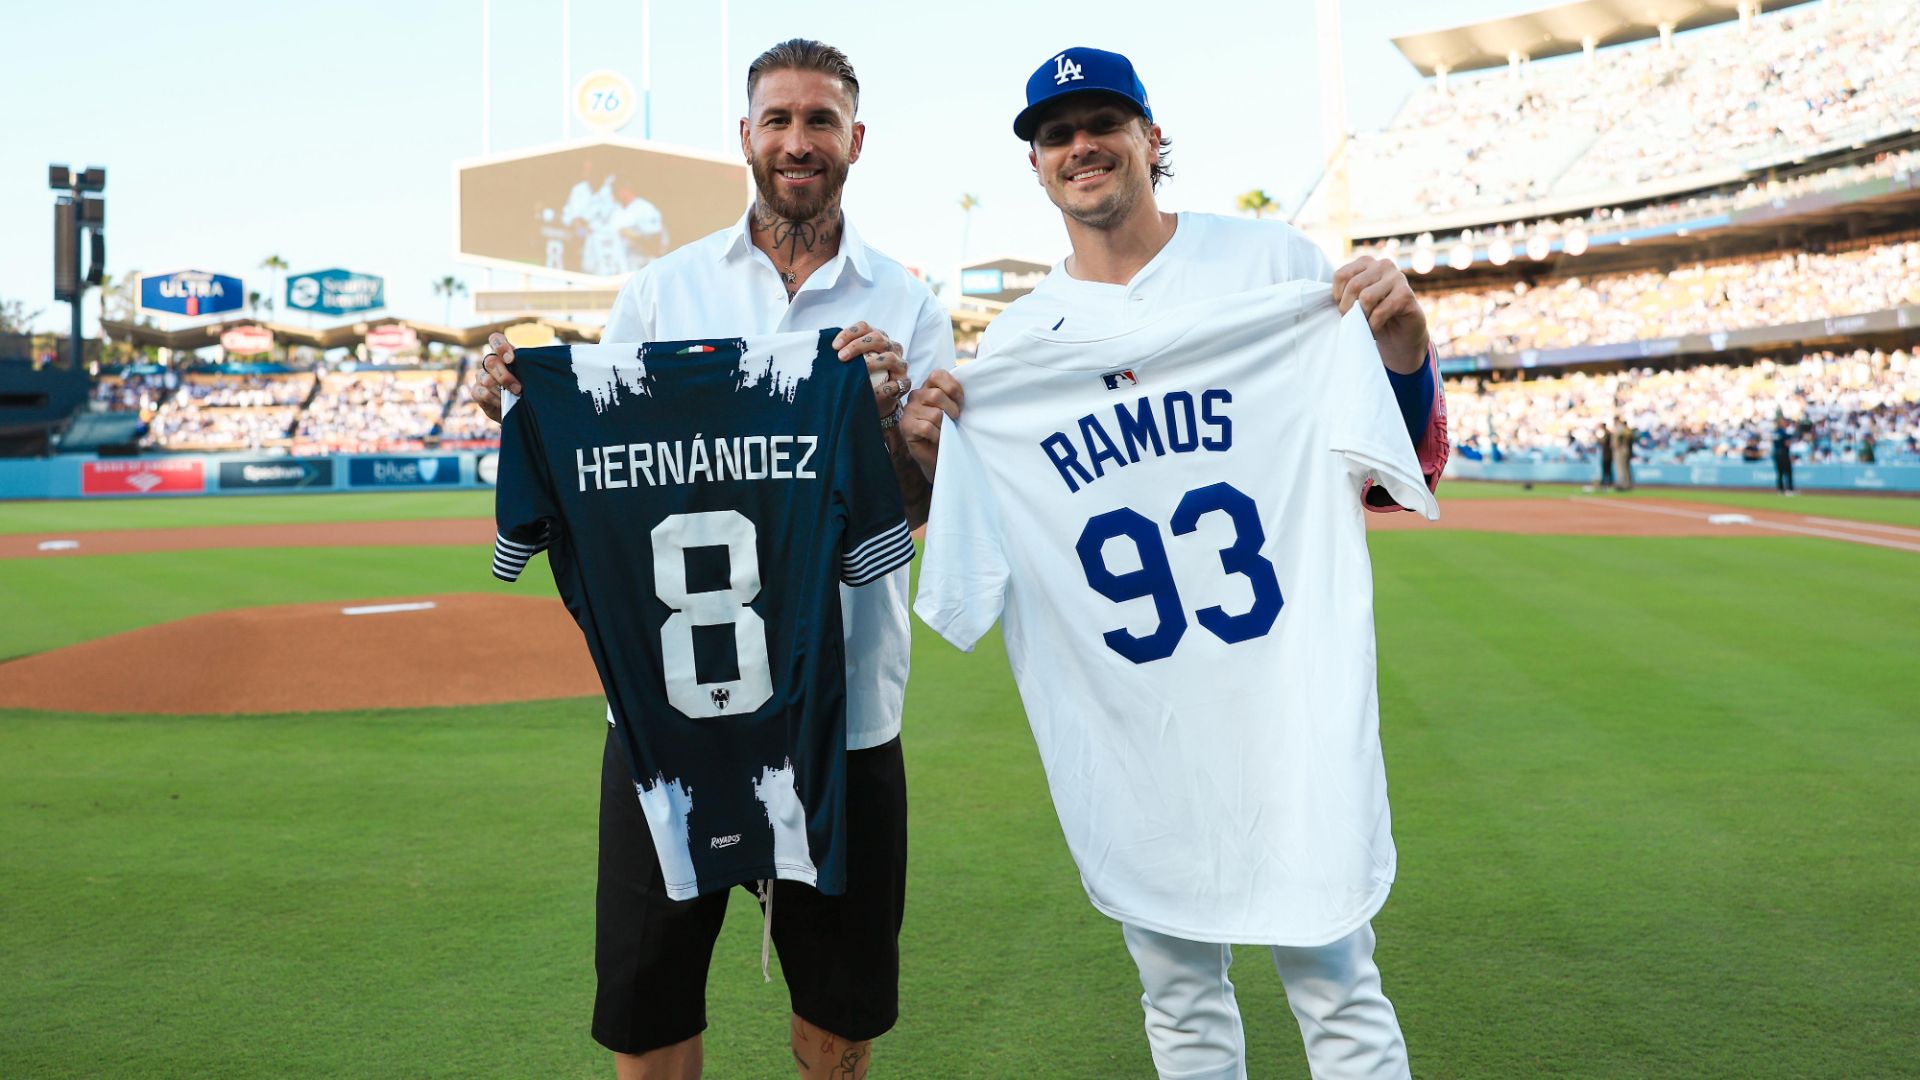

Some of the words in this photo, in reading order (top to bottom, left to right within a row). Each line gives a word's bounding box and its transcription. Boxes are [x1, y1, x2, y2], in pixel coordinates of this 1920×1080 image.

[1054, 54, 1085, 85] LA
[592, 90, 620, 112] 76
[160, 280, 224, 298] ULTRA
[1040, 388, 1233, 493] RAMOS
[373, 461, 417, 480] blue
[576, 433, 819, 491] HERNÁNDEZ
[1075, 481, 1284, 664] 93
[651, 510, 774, 719] 8
[711, 834, 741, 849] RAYADOS
